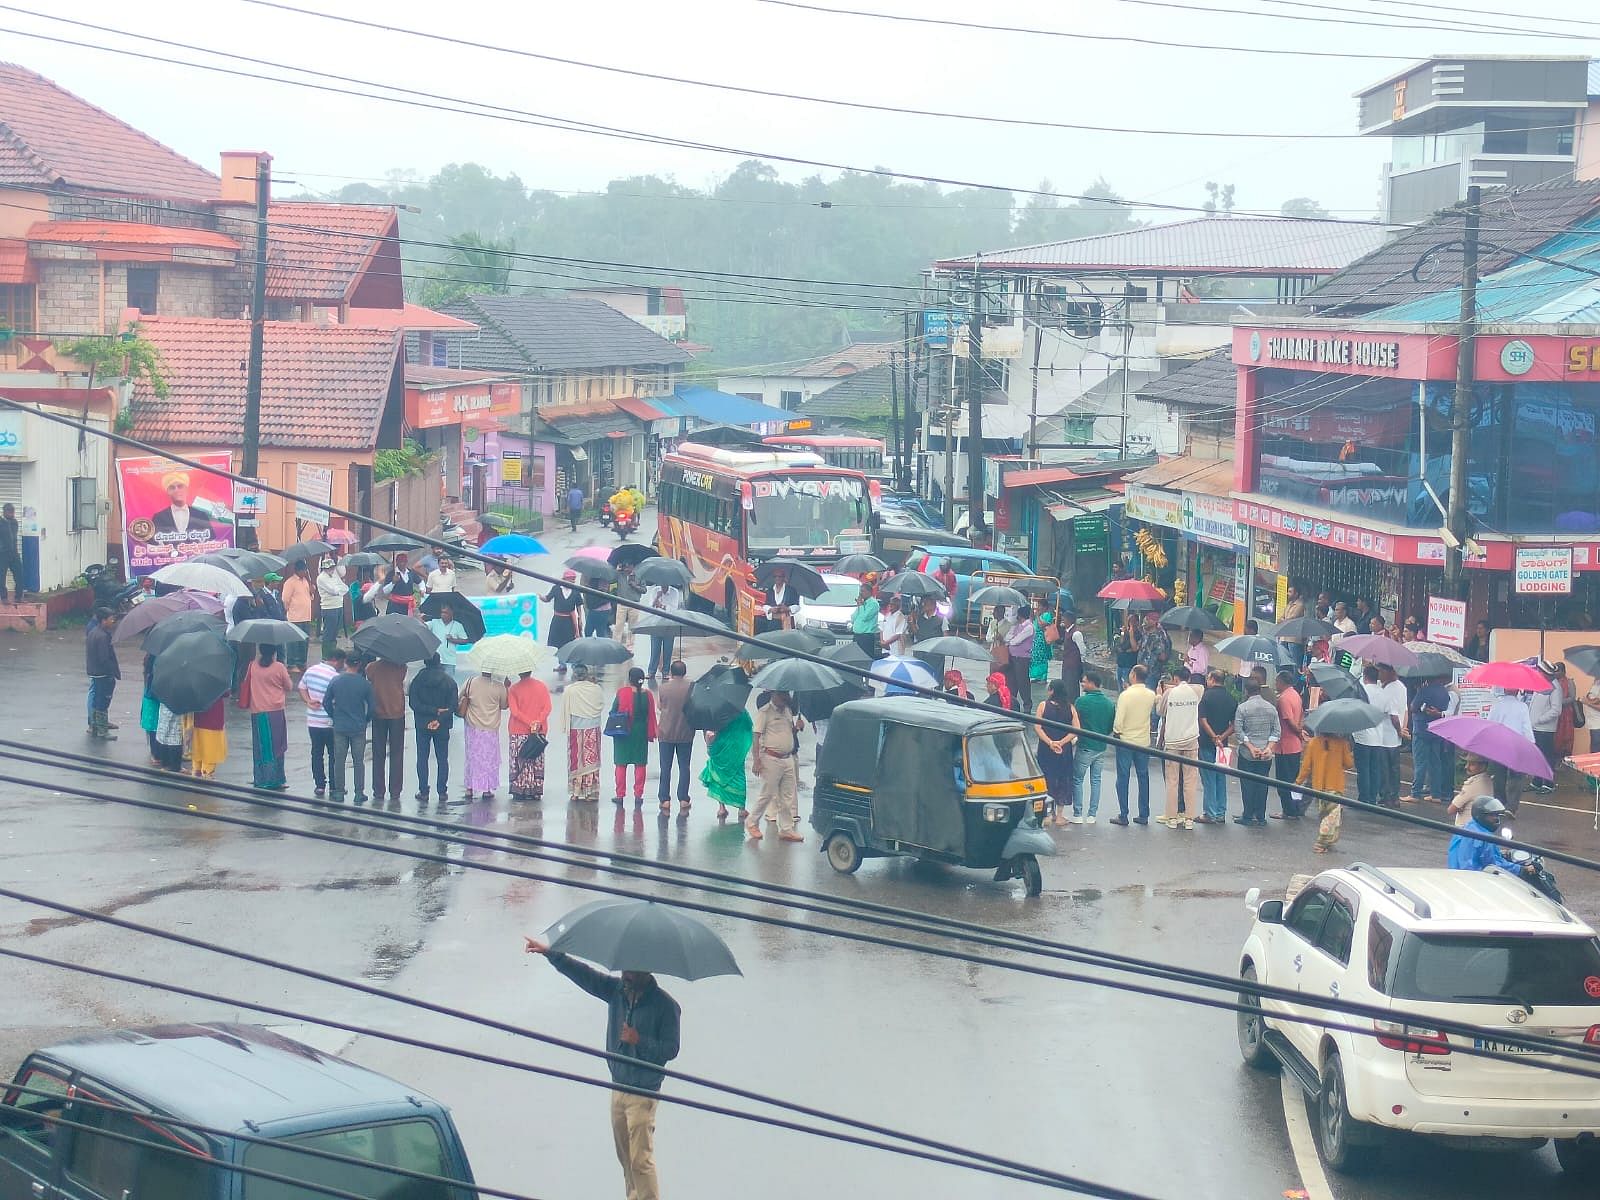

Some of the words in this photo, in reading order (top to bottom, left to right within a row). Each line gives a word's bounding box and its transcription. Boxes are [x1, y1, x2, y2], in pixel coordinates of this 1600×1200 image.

[1267, 337, 1314, 362] SHABARI
[1317, 340, 1351, 364] BAKE
[1353, 342, 1398, 369] HOUSE
[1569, 345, 1600, 371] S
[701, 473, 714, 491] CAR
[755, 477, 863, 500] DIVYAVANI
[1518, 570, 1547, 580] GOLDEN
[1549, 570, 1568, 579] GATE
[1520, 582, 1566, 591] LODGING
[1430, 602, 1438, 611] NO
[1439, 603, 1463, 614] PARKING
